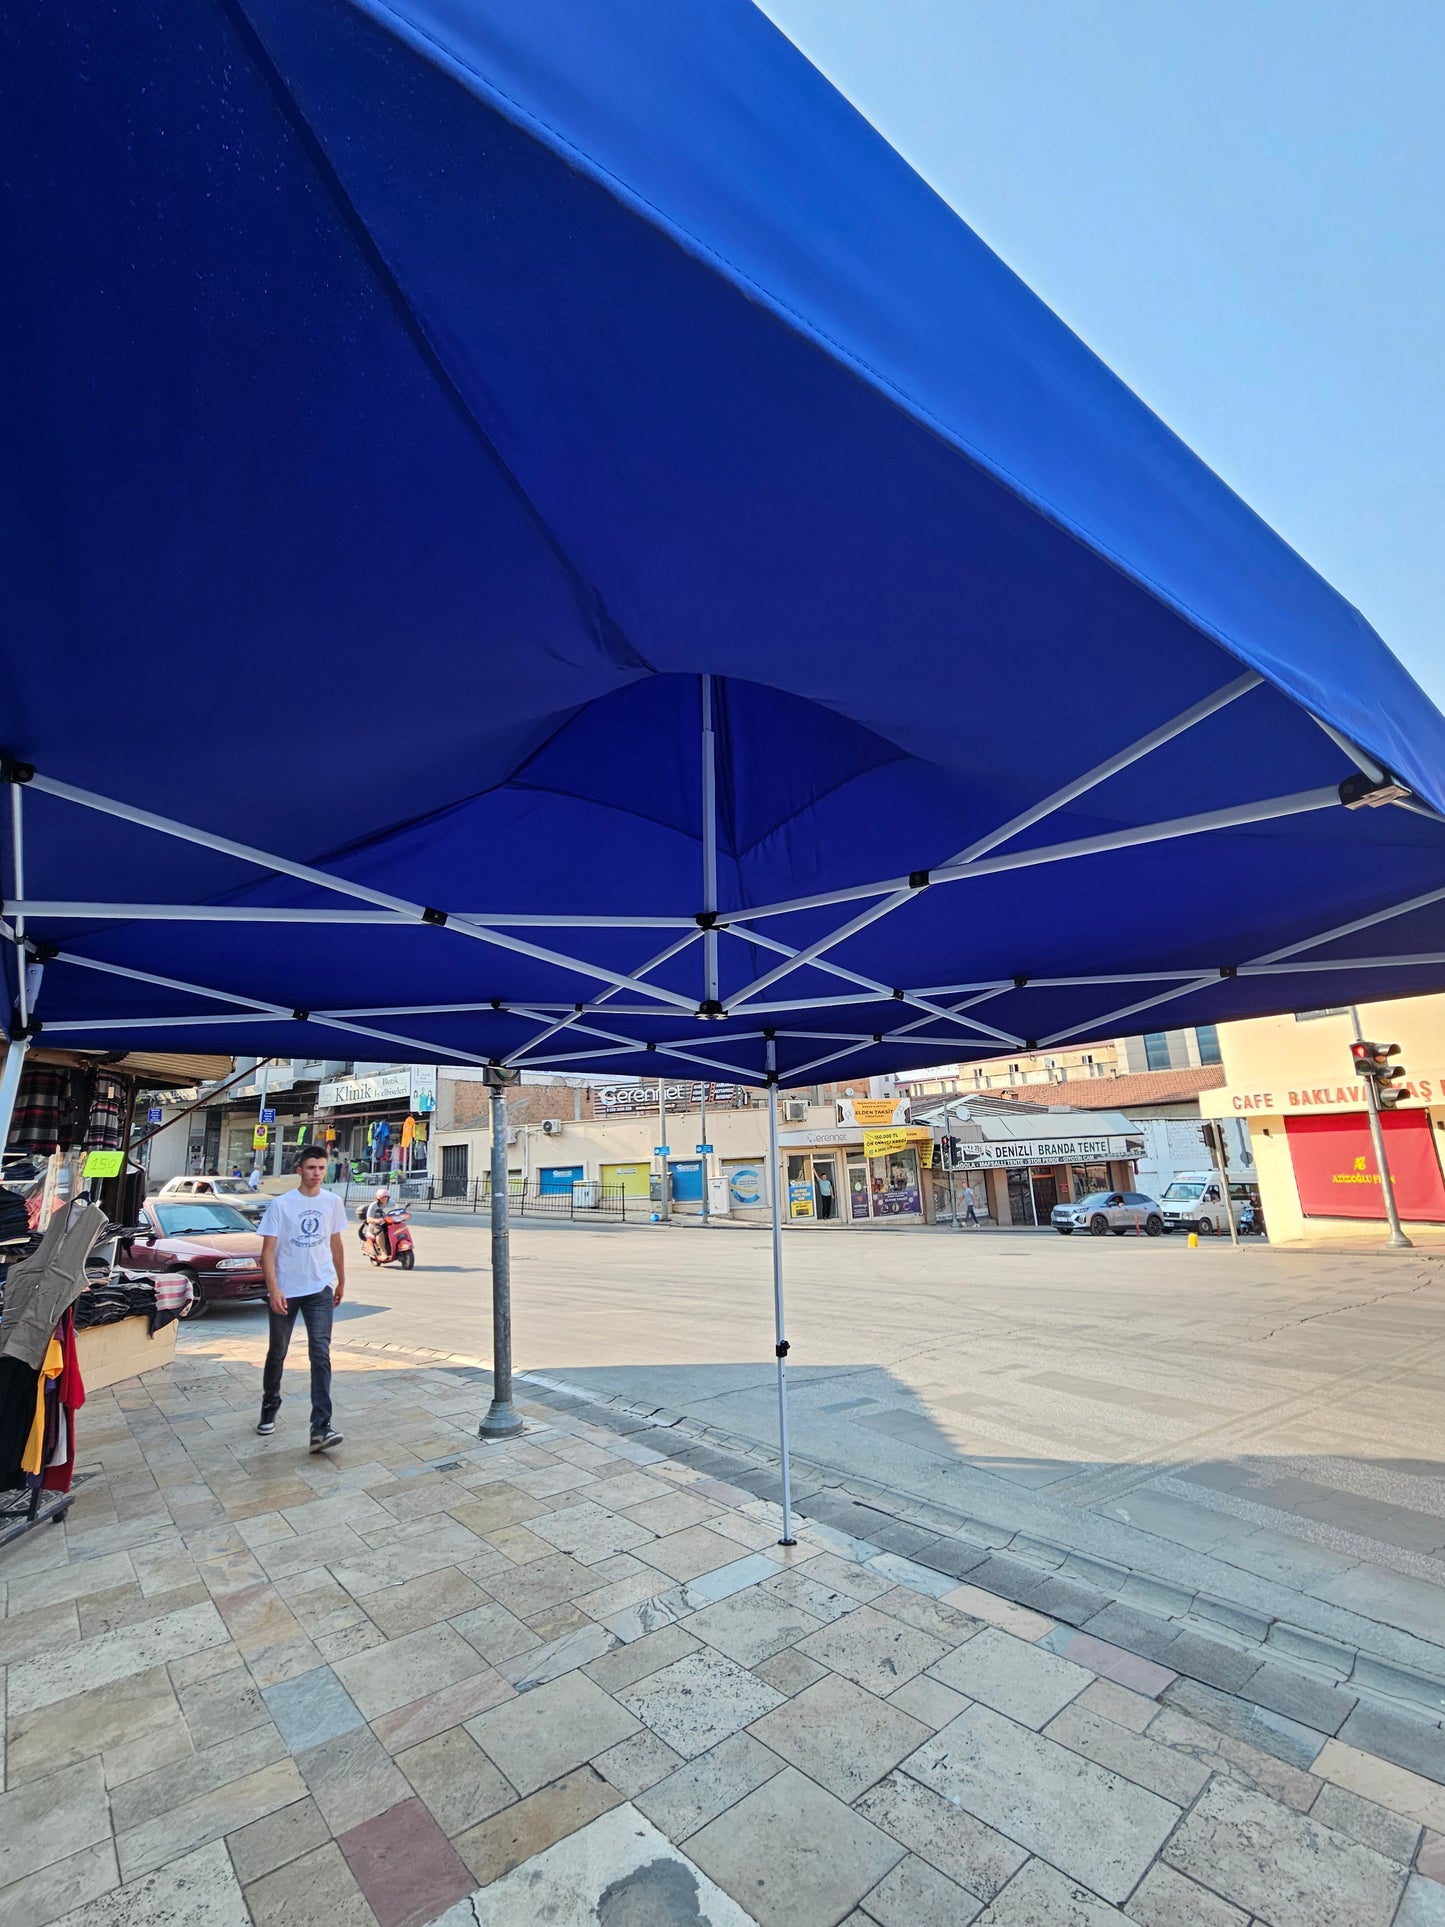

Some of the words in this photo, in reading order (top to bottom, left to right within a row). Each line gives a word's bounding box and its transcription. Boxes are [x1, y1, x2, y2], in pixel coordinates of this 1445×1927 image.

[382, 1077, 399, 1086] Butik
[335, 1084, 371, 1102] Klinik
[1232, 1093, 1274, 1110] CAFE
[996, 1143, 1033, 1158] DENİZLİ
[1038, 1143, 1076, 1155] BRANDA
[1078, 1141, 1106, 1153] TENTE
